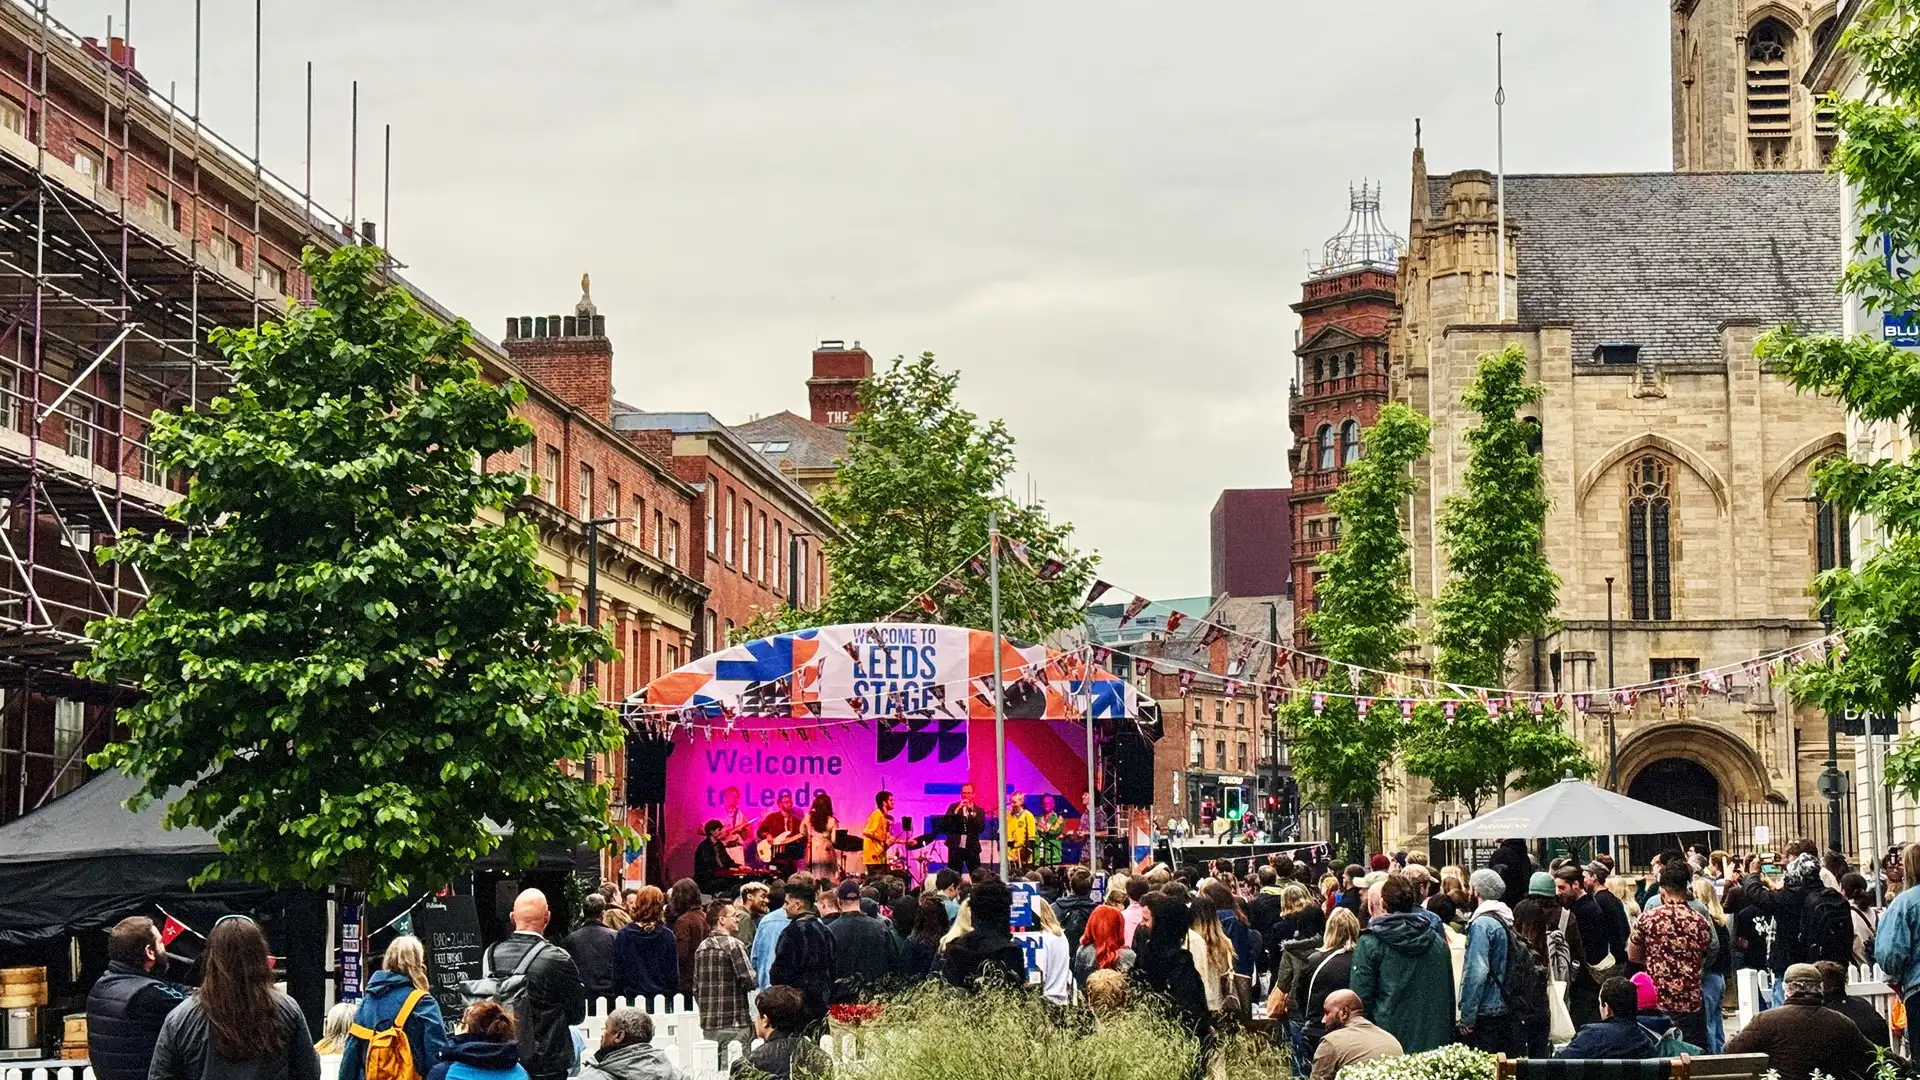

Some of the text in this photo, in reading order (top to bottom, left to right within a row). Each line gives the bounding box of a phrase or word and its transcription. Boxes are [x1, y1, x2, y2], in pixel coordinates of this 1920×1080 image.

[1885, 326, 1919, 337] BLU
[826, 411, 849, 423] THE
[853, 628, 936, 644] WECOME TO
[853, 645, 936, 680] LEEDS
[853, 680, 936, 715] STAGE
[706, 749, 842, 775] Welcome
